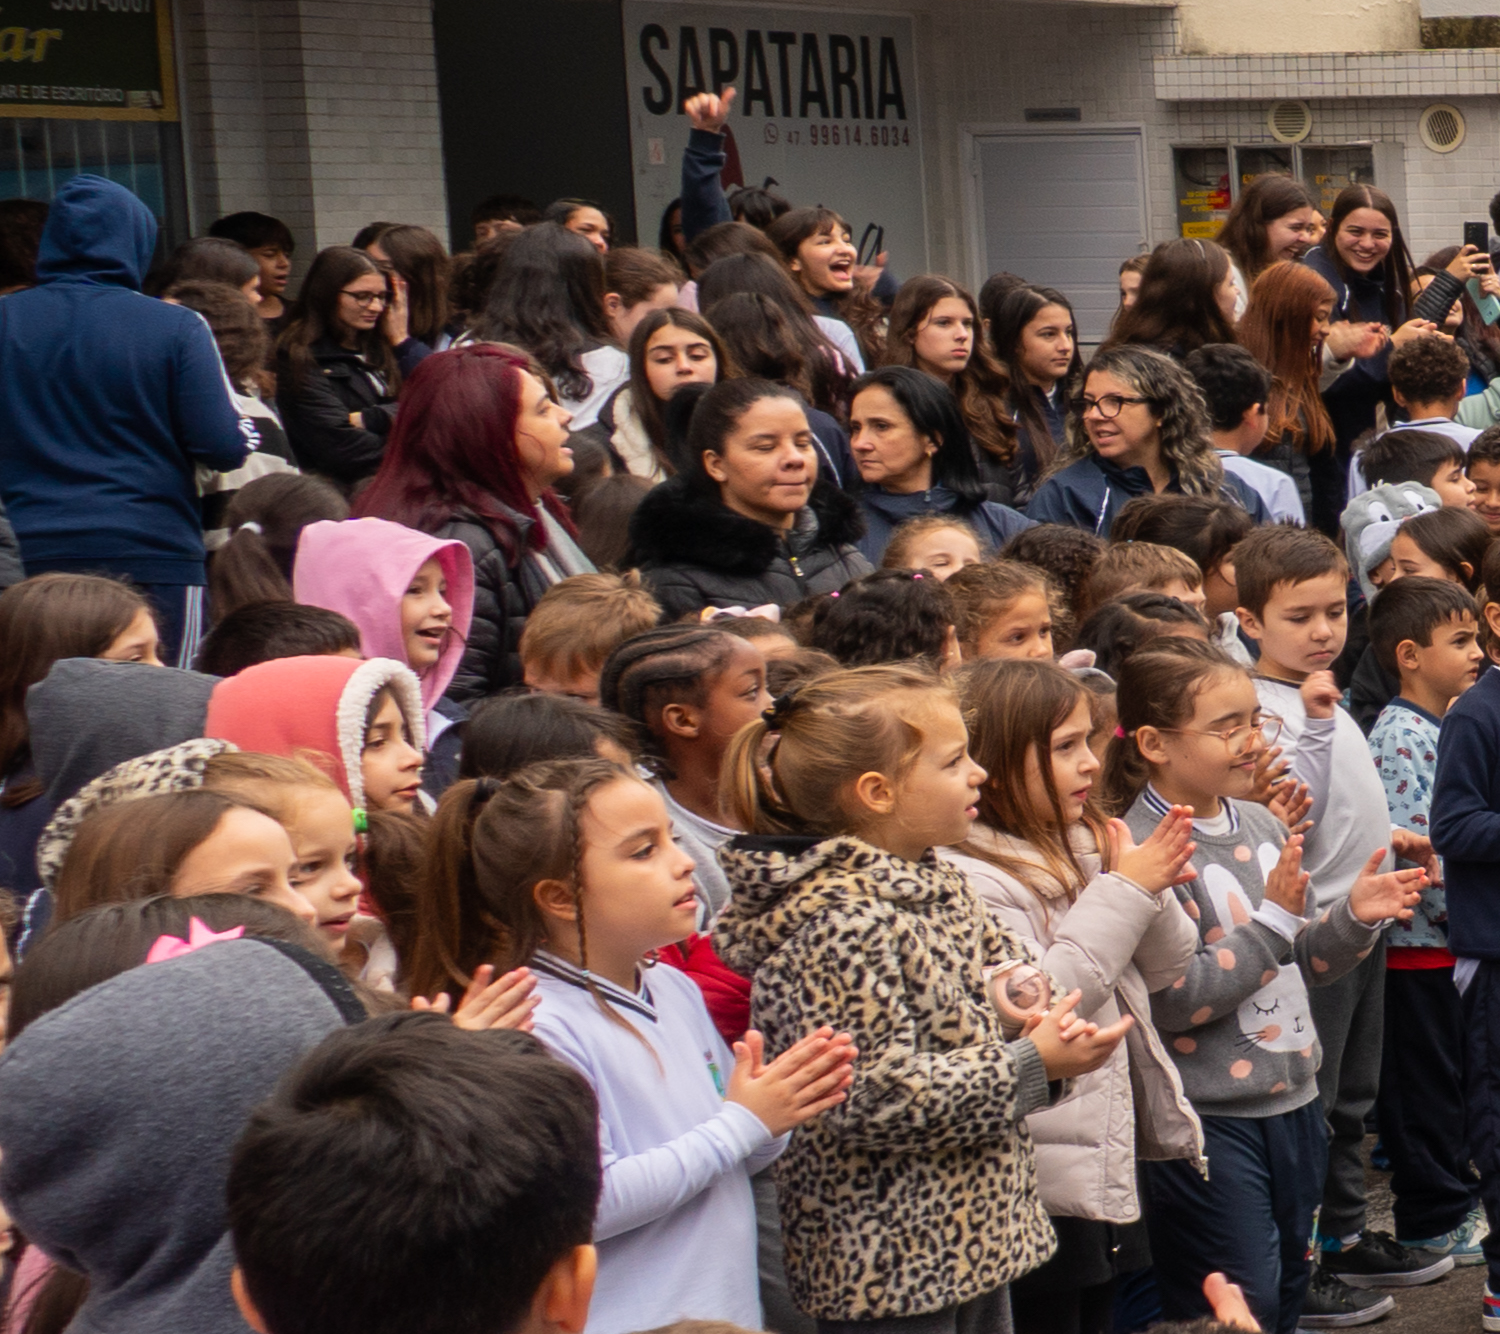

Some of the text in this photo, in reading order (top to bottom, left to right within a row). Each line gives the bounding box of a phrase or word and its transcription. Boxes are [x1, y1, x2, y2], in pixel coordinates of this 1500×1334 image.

[639, 22, 908, 121] SAPATARIA
[20, 85, 30, 100] E
[32, 86, 49, 101] DE
[809, 124, 910, 148] 99614.6034
